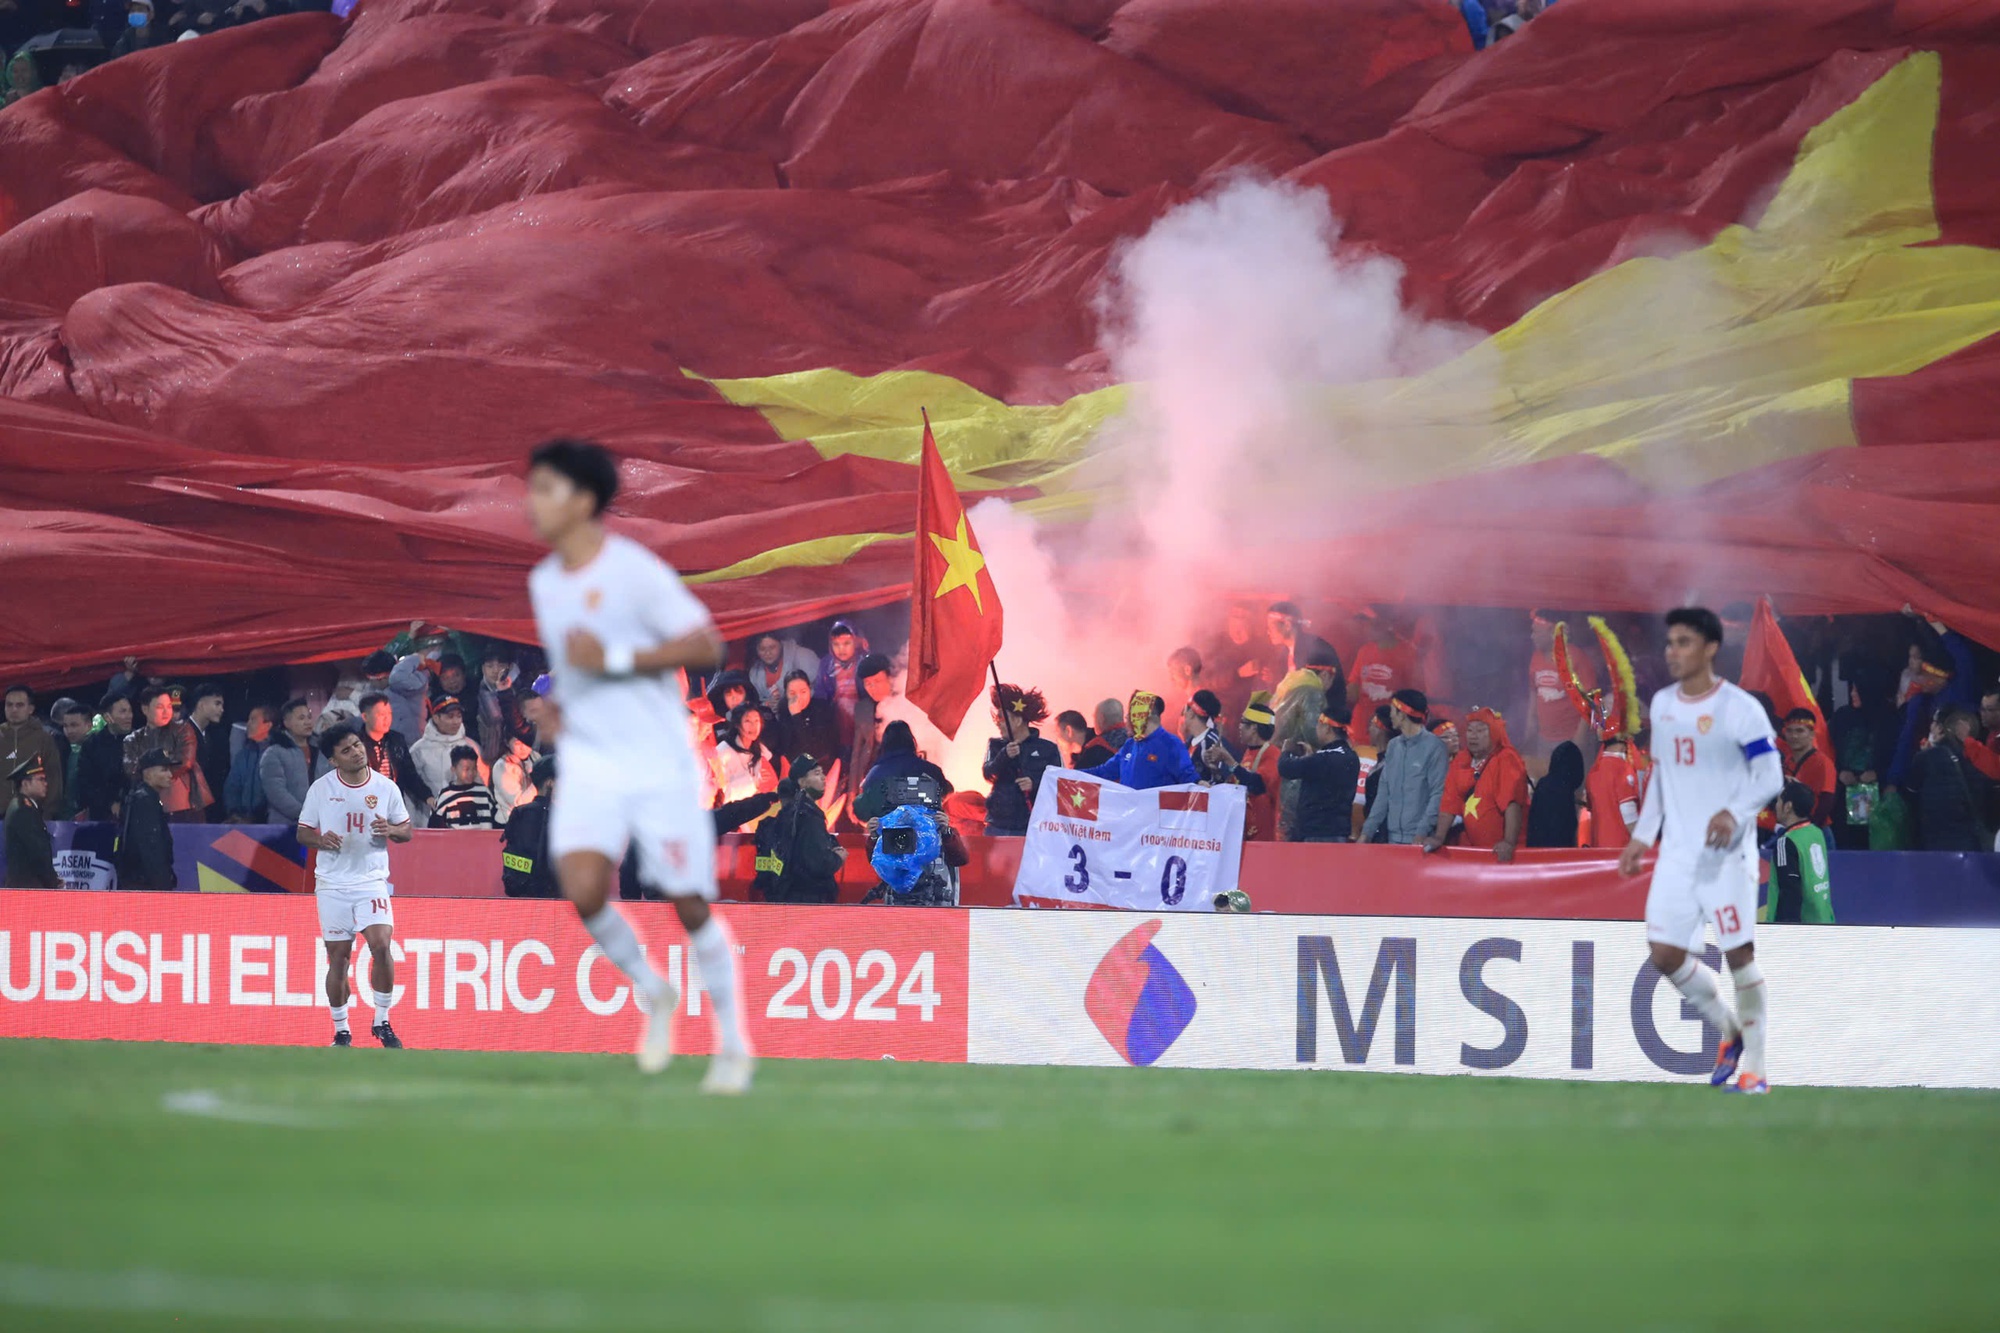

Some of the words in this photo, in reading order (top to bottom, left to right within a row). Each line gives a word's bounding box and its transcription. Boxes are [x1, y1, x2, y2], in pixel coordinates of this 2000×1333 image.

[1674, 736, 1695, 766] 13
[346, 811, 364, 833] 14
[1088, 826, 1111, 841] Nam
[61, 855, 91, 869] ASEAN
[1064, 844, 1089, 893] 3
[1160, 855, 1187, 905] 0
[370, 898, 389, 914] 14
[1715, 904, 1741, 935] 13
[0, 930, 210, 1004] UBISHI
[230, 935, 555, 1013] ELECTRIC
[766, 947, 942, 1022] 2024
[1296, 935, 1723, 1075] MSIG
